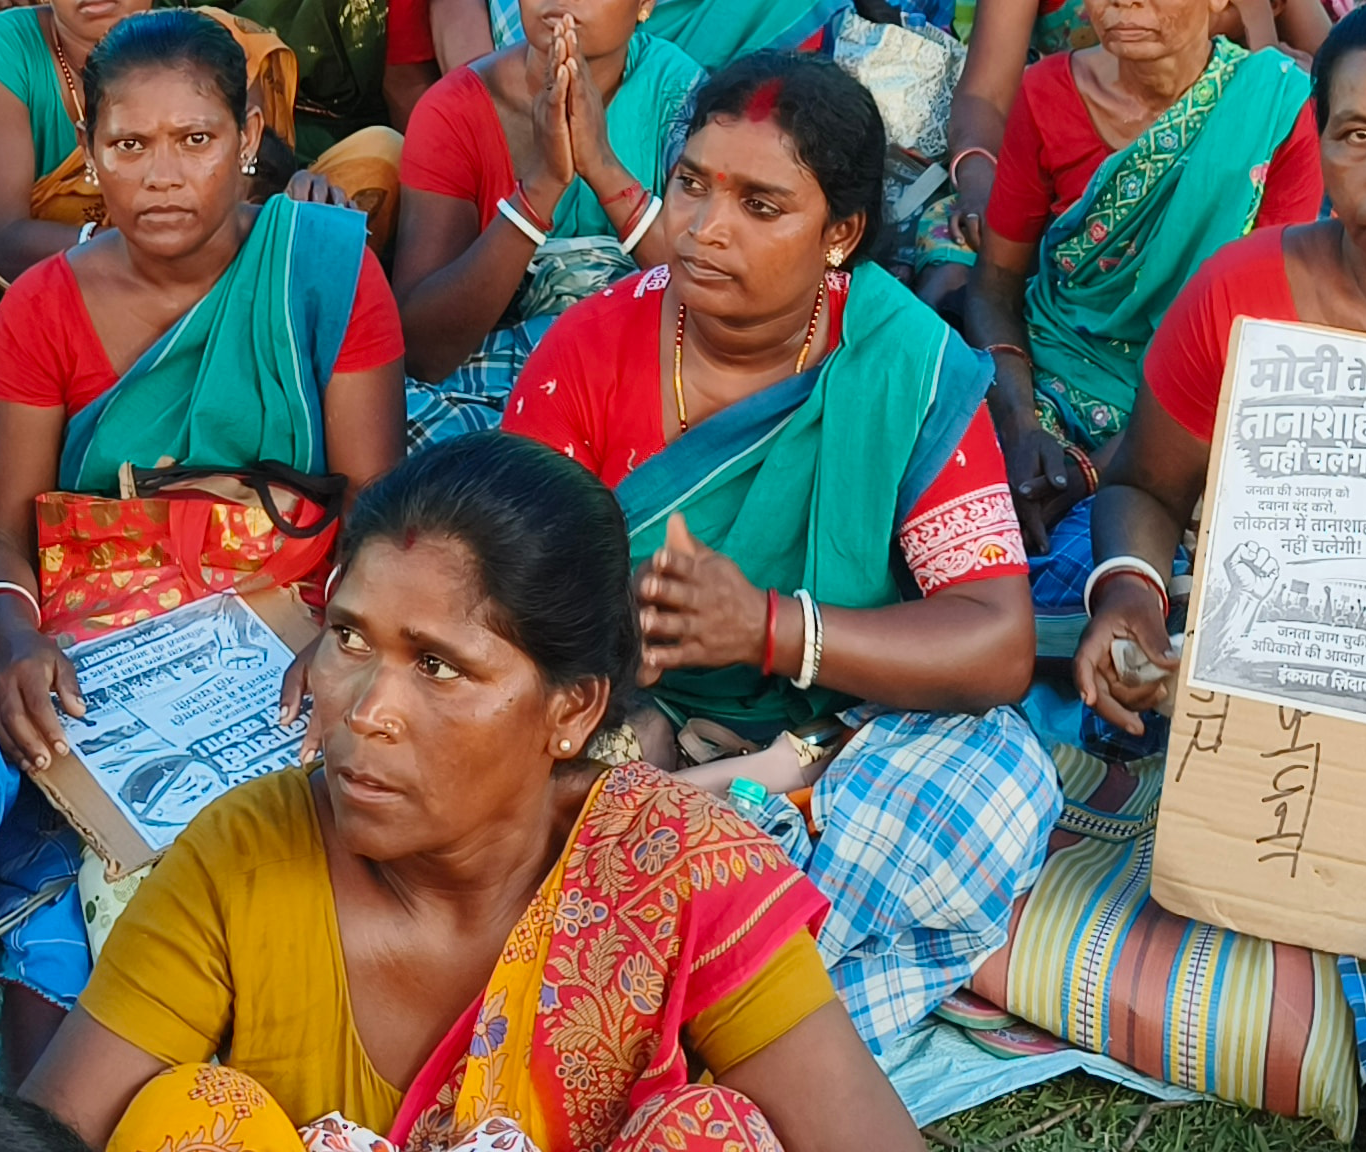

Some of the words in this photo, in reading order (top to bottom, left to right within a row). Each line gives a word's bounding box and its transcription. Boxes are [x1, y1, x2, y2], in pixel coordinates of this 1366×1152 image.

[1250, 344, 1344, 395] मोदी
[1259, 439, 1307, 474] नहीं
[1245, 485, 1274, 496] जनता
[1277, 483, 1292, 496] की
[1295, 485, 1332, 498] आवाज़
[1335, 486, 1350, 498] को
[1233, 511, 1291, 531] लोकतंत्र
[1295, 513, 1308, 532] में
[1281, 534, 1310, 555] नहीं
[1312, 535, 1362, 555] चलेगी!
[1277, 625, 1310, 641] जनता
[1314, 630, 1339, 644] जाग
[1251, 637, 1301, 657] अधिकारों
[1305, 644, 1321, 660] की
[1325, 650, 1364, 667] आवाज़
[1255, 705, 1320, 878] अपना
